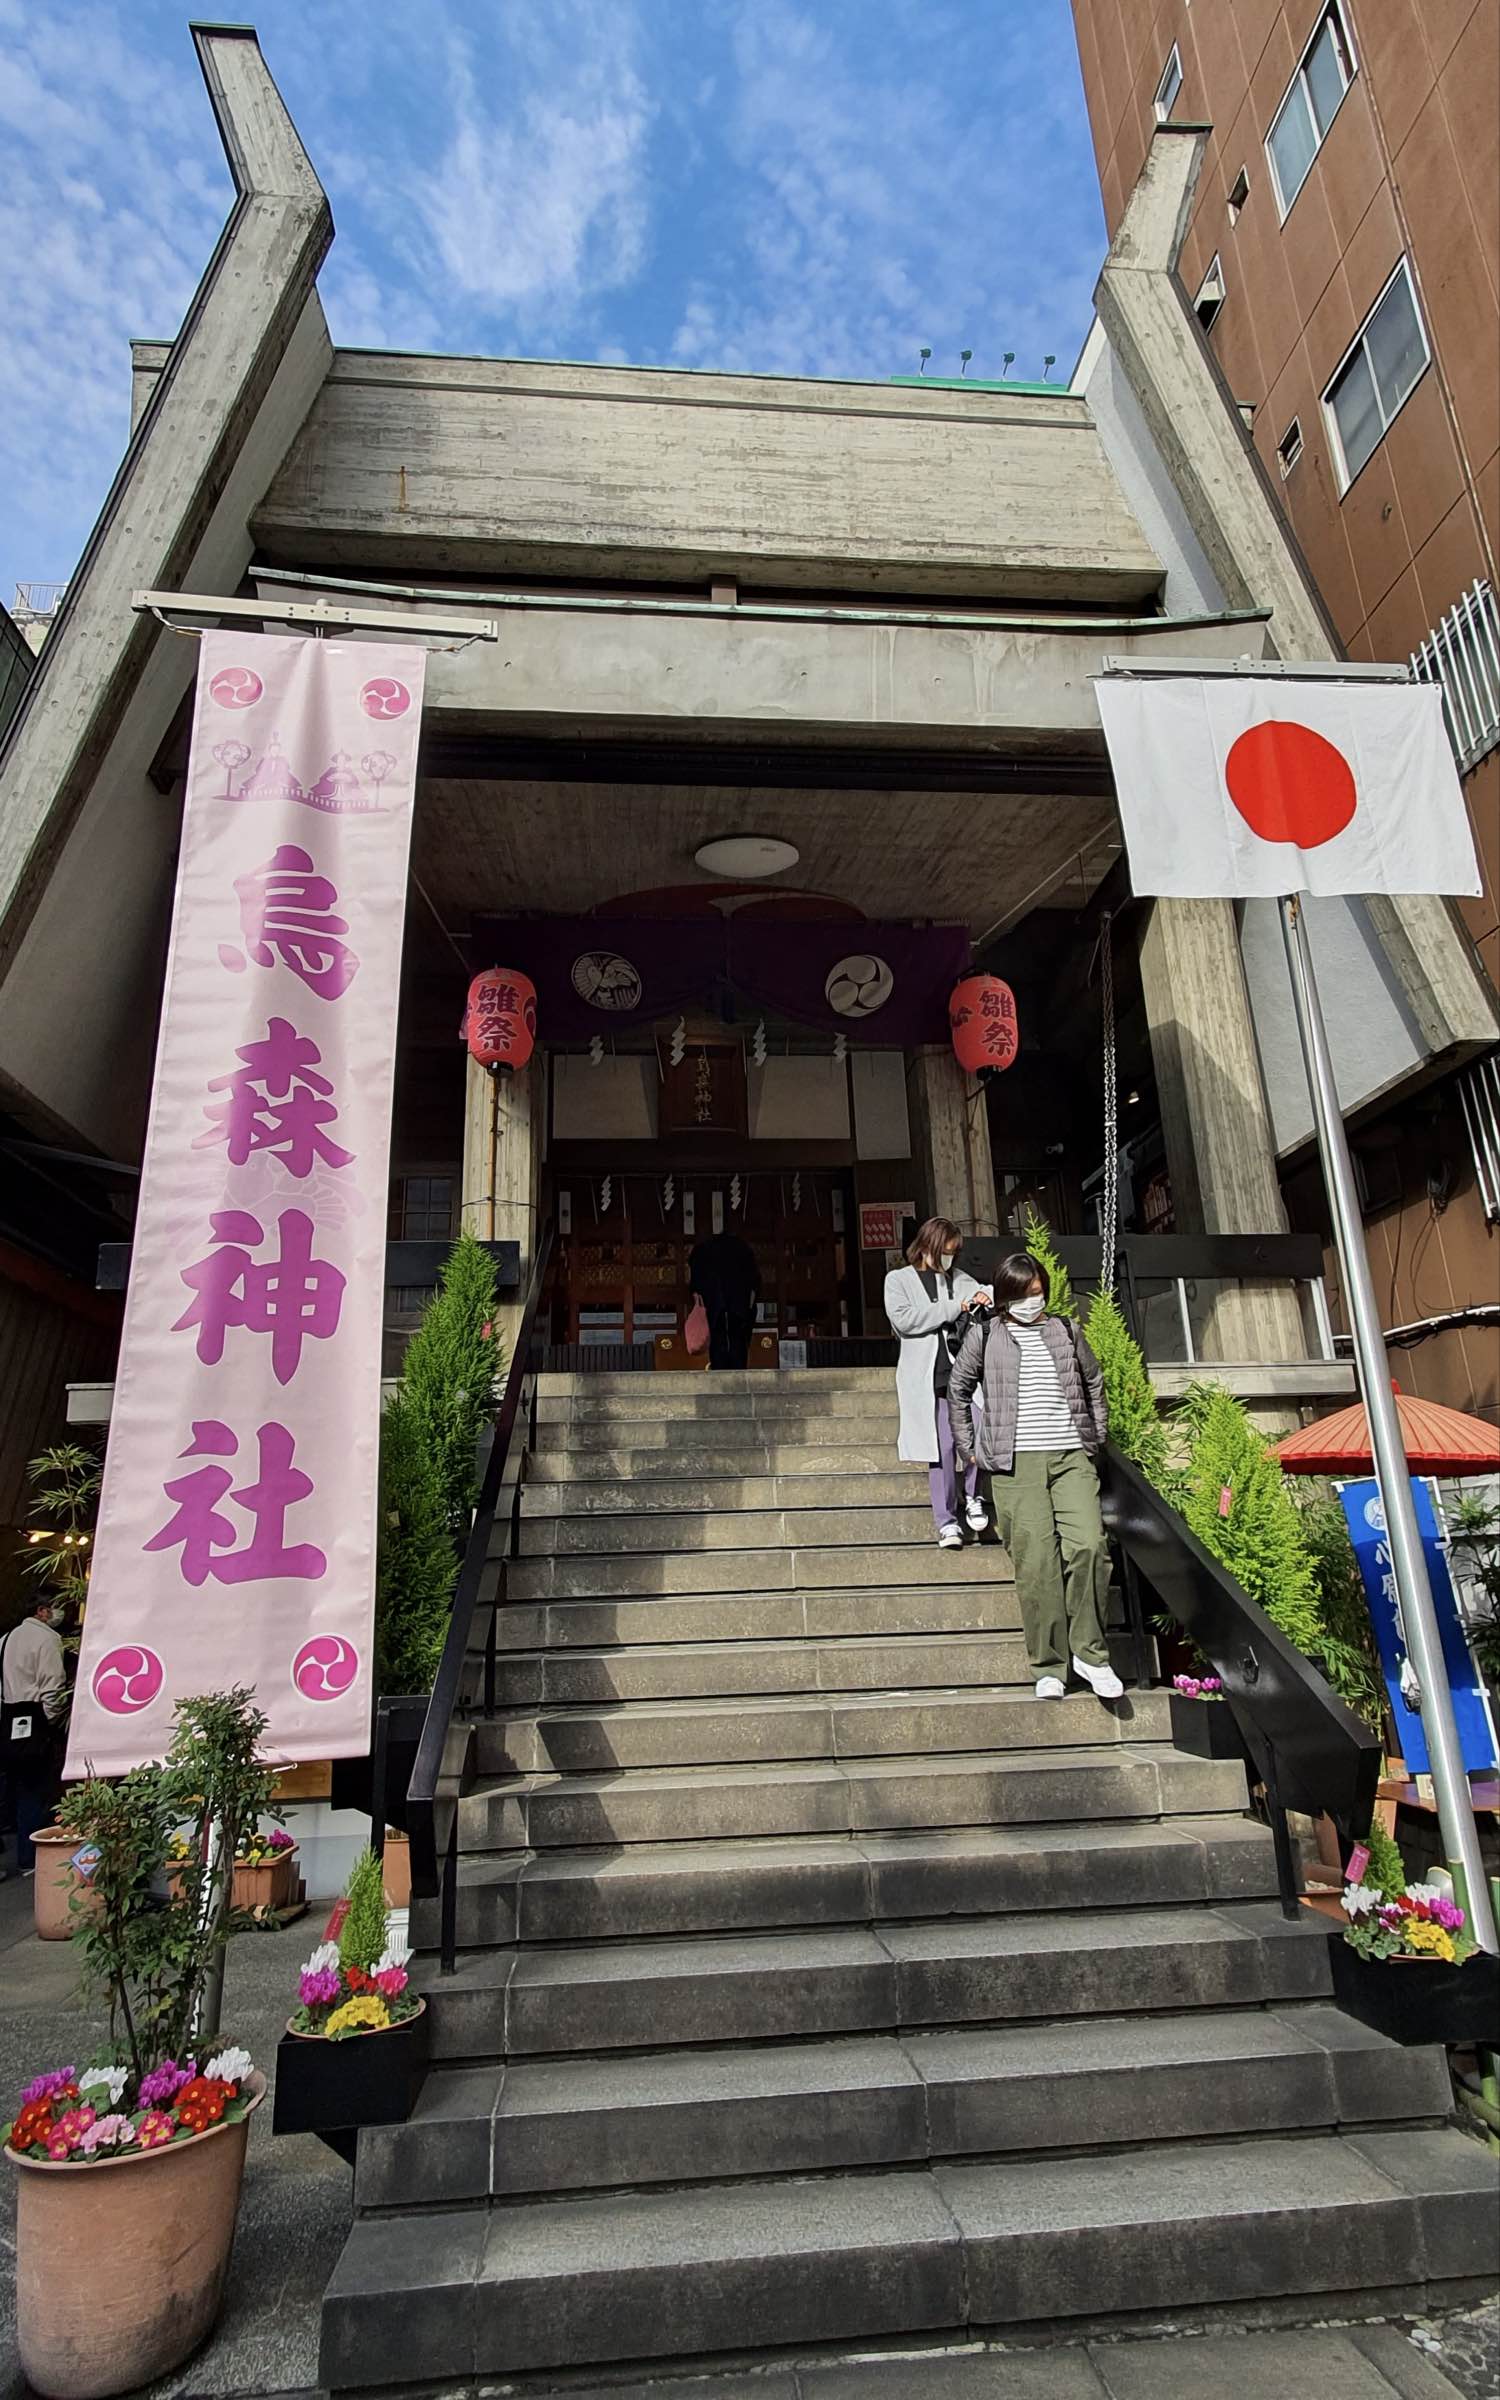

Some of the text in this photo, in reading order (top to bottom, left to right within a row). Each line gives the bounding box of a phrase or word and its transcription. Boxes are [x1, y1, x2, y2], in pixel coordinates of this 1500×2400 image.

[477, 983, 520, 1051] 雛祭
[978, 990, 1015, 1057] 雛祭
[142, 844, 360, 1587] 烏森神社
